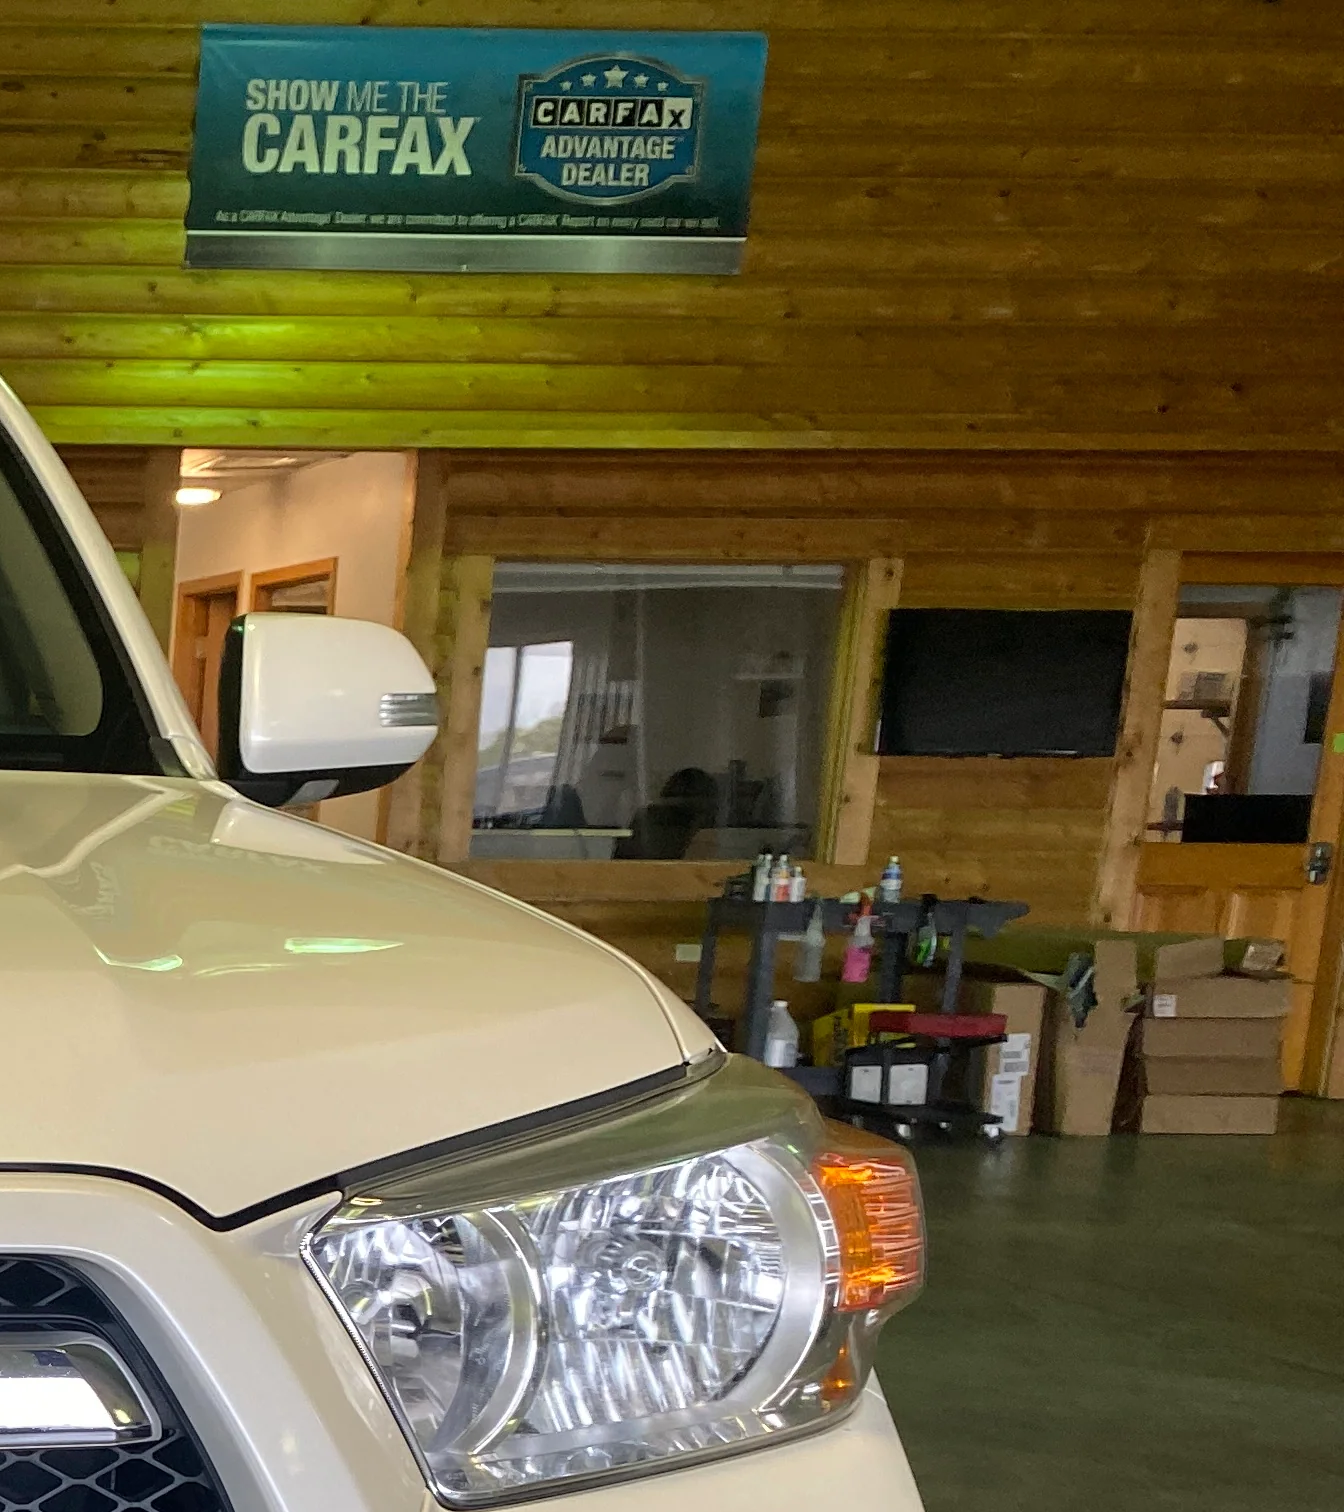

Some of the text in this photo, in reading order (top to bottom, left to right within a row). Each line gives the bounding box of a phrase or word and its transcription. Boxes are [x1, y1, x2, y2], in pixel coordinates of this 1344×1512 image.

[246, 79, 448, 114] SHOW ME THE
[536, 101, 686, 129] CARFAX
[243, 113, 475, 175] CARFAX
[540, 135, 676, 160] ADVANTAGE
[562, 163, 650, 187] DEALER
